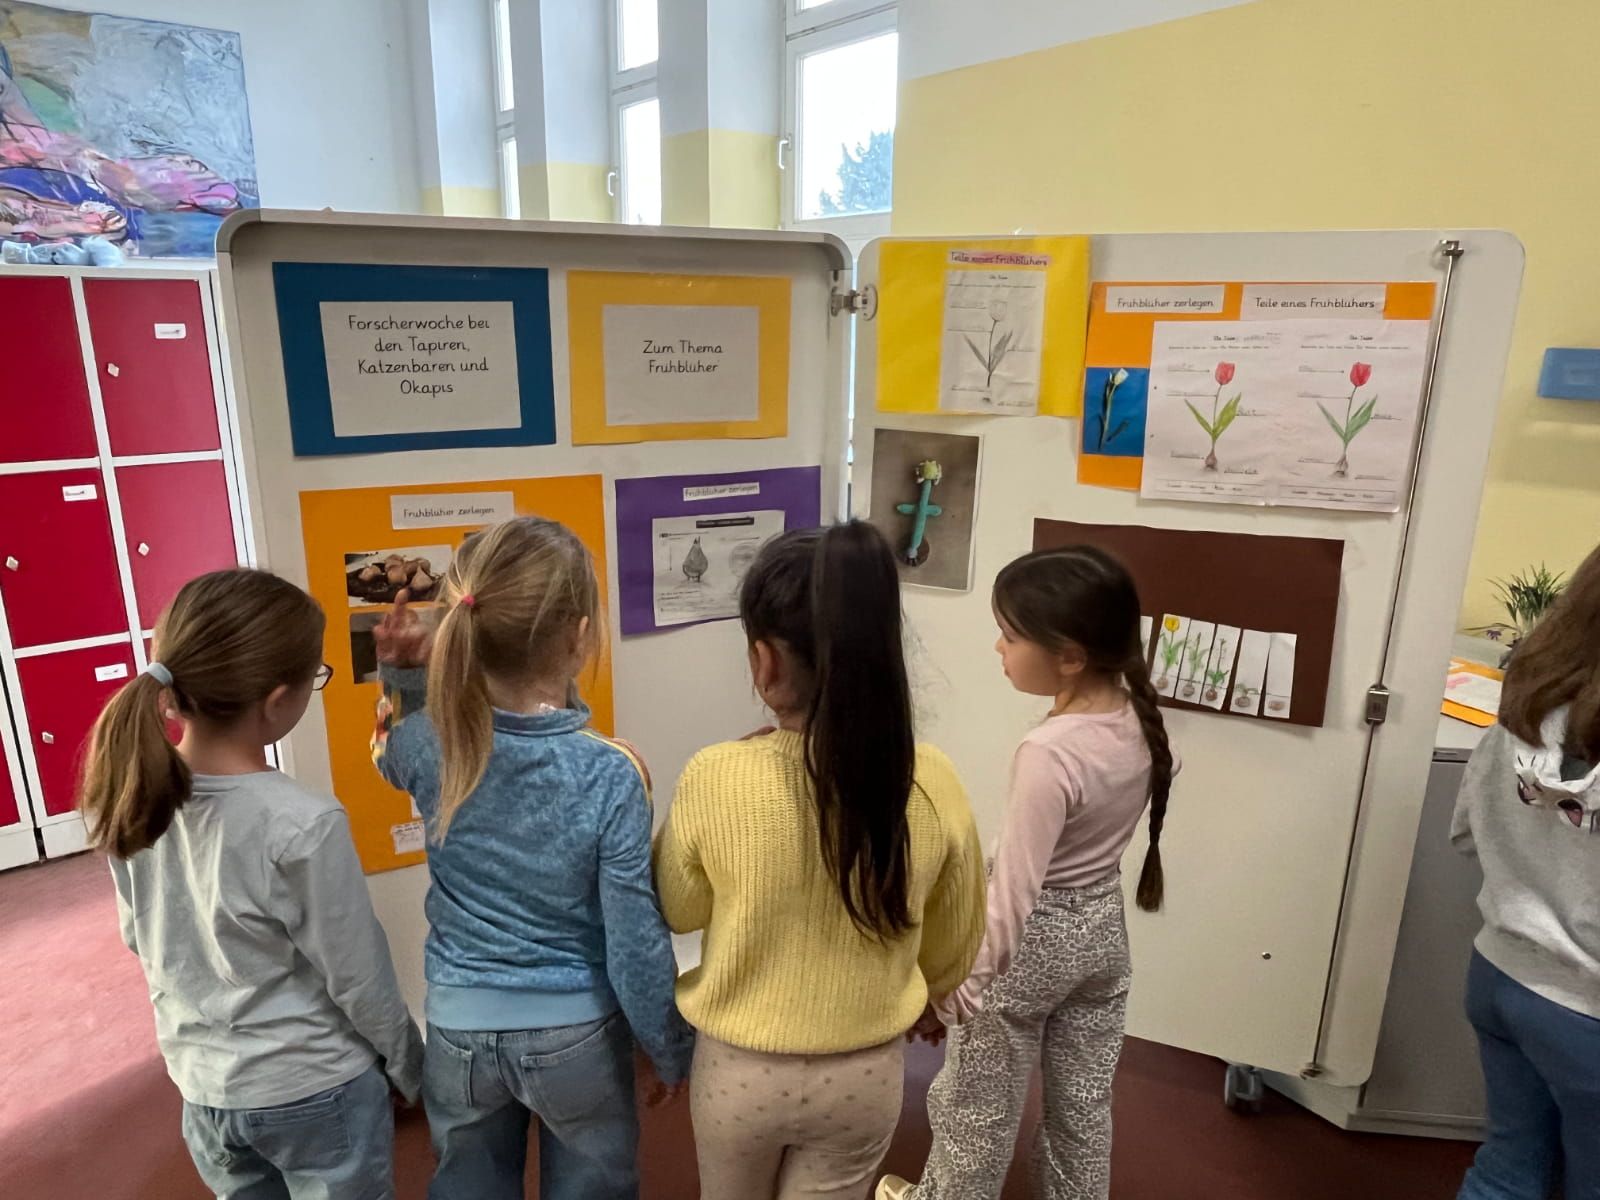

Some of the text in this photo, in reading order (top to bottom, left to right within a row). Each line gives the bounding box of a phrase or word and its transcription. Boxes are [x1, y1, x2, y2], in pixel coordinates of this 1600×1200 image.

[1173, 297, 1214, 310] zerlegen
[1254, 297, 1278, 308] Teile
[1280, 300, 1307, 308] eines
[348, 314, 490, 330] Forscherwoche bei
[374, 337, 403, 352] den
[642, 339, 724, 354] Zum Thema
[460, 356, 489, 372] und
[400, 379, 454, 398] Okapis
